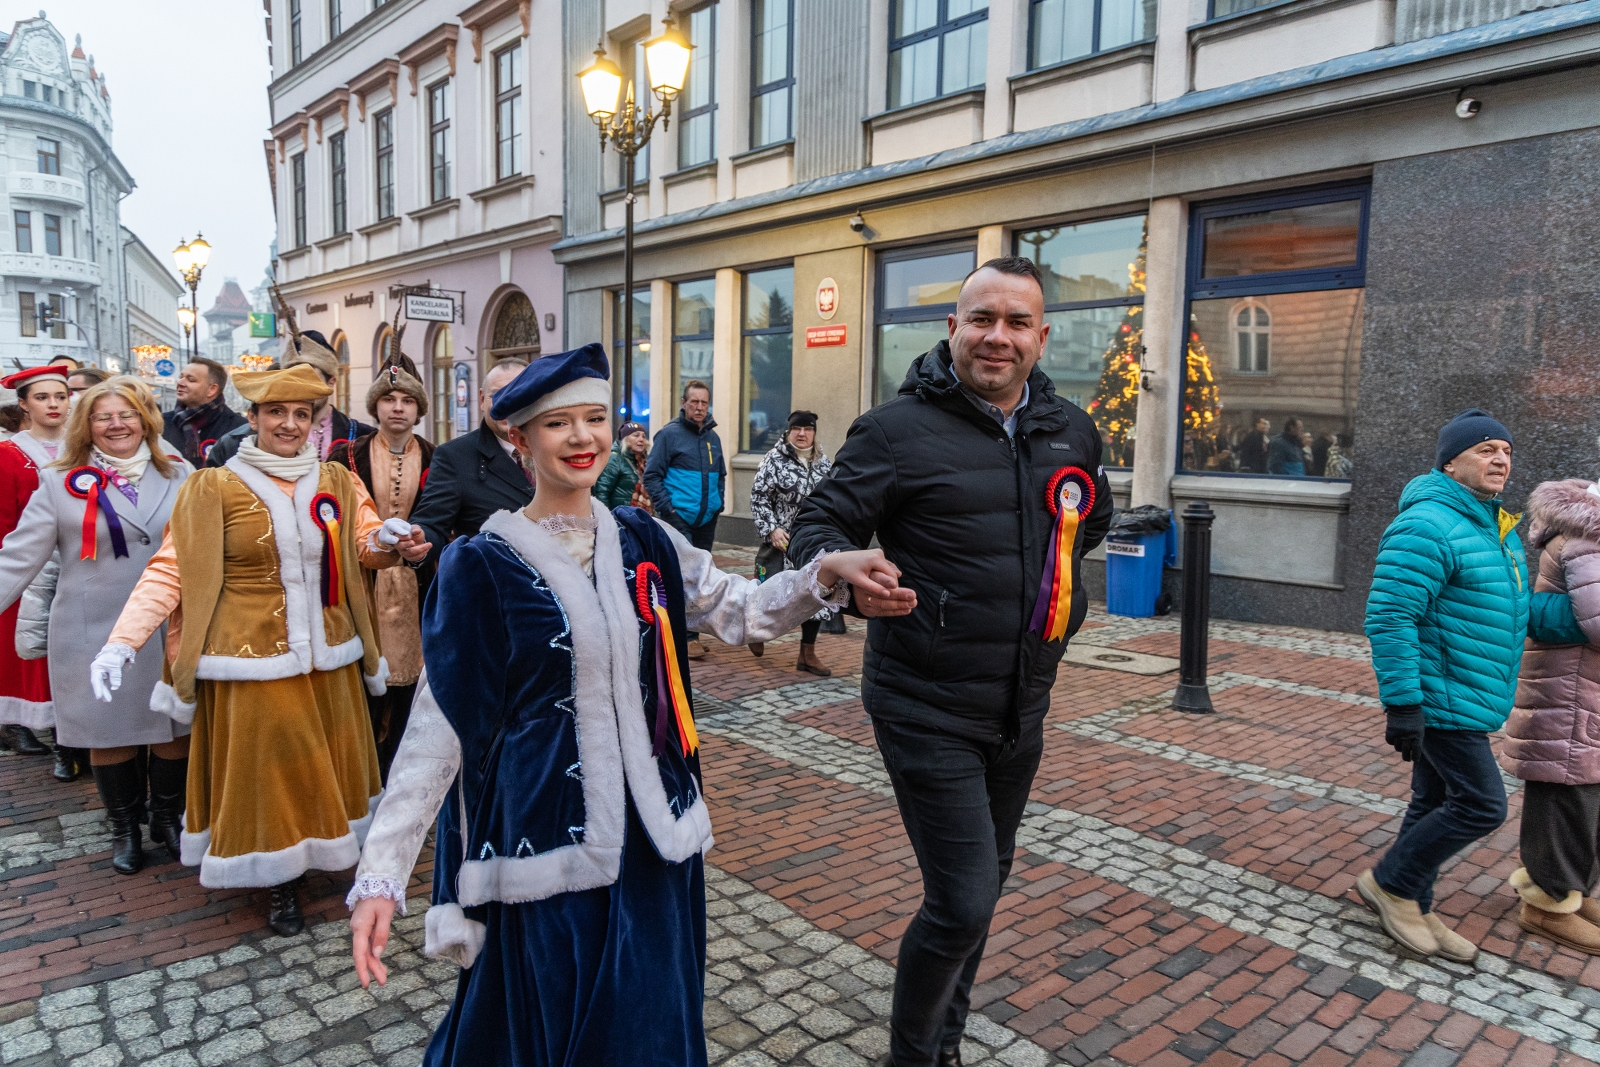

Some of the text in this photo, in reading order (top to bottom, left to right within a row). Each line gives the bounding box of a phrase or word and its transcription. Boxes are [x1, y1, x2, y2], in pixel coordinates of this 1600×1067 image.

[410, 299, 450, 309] KANCELARIA
[410, 308, 450, 318] NOTARIALNA
[1107, 544, 1140, 554] DROMAR
